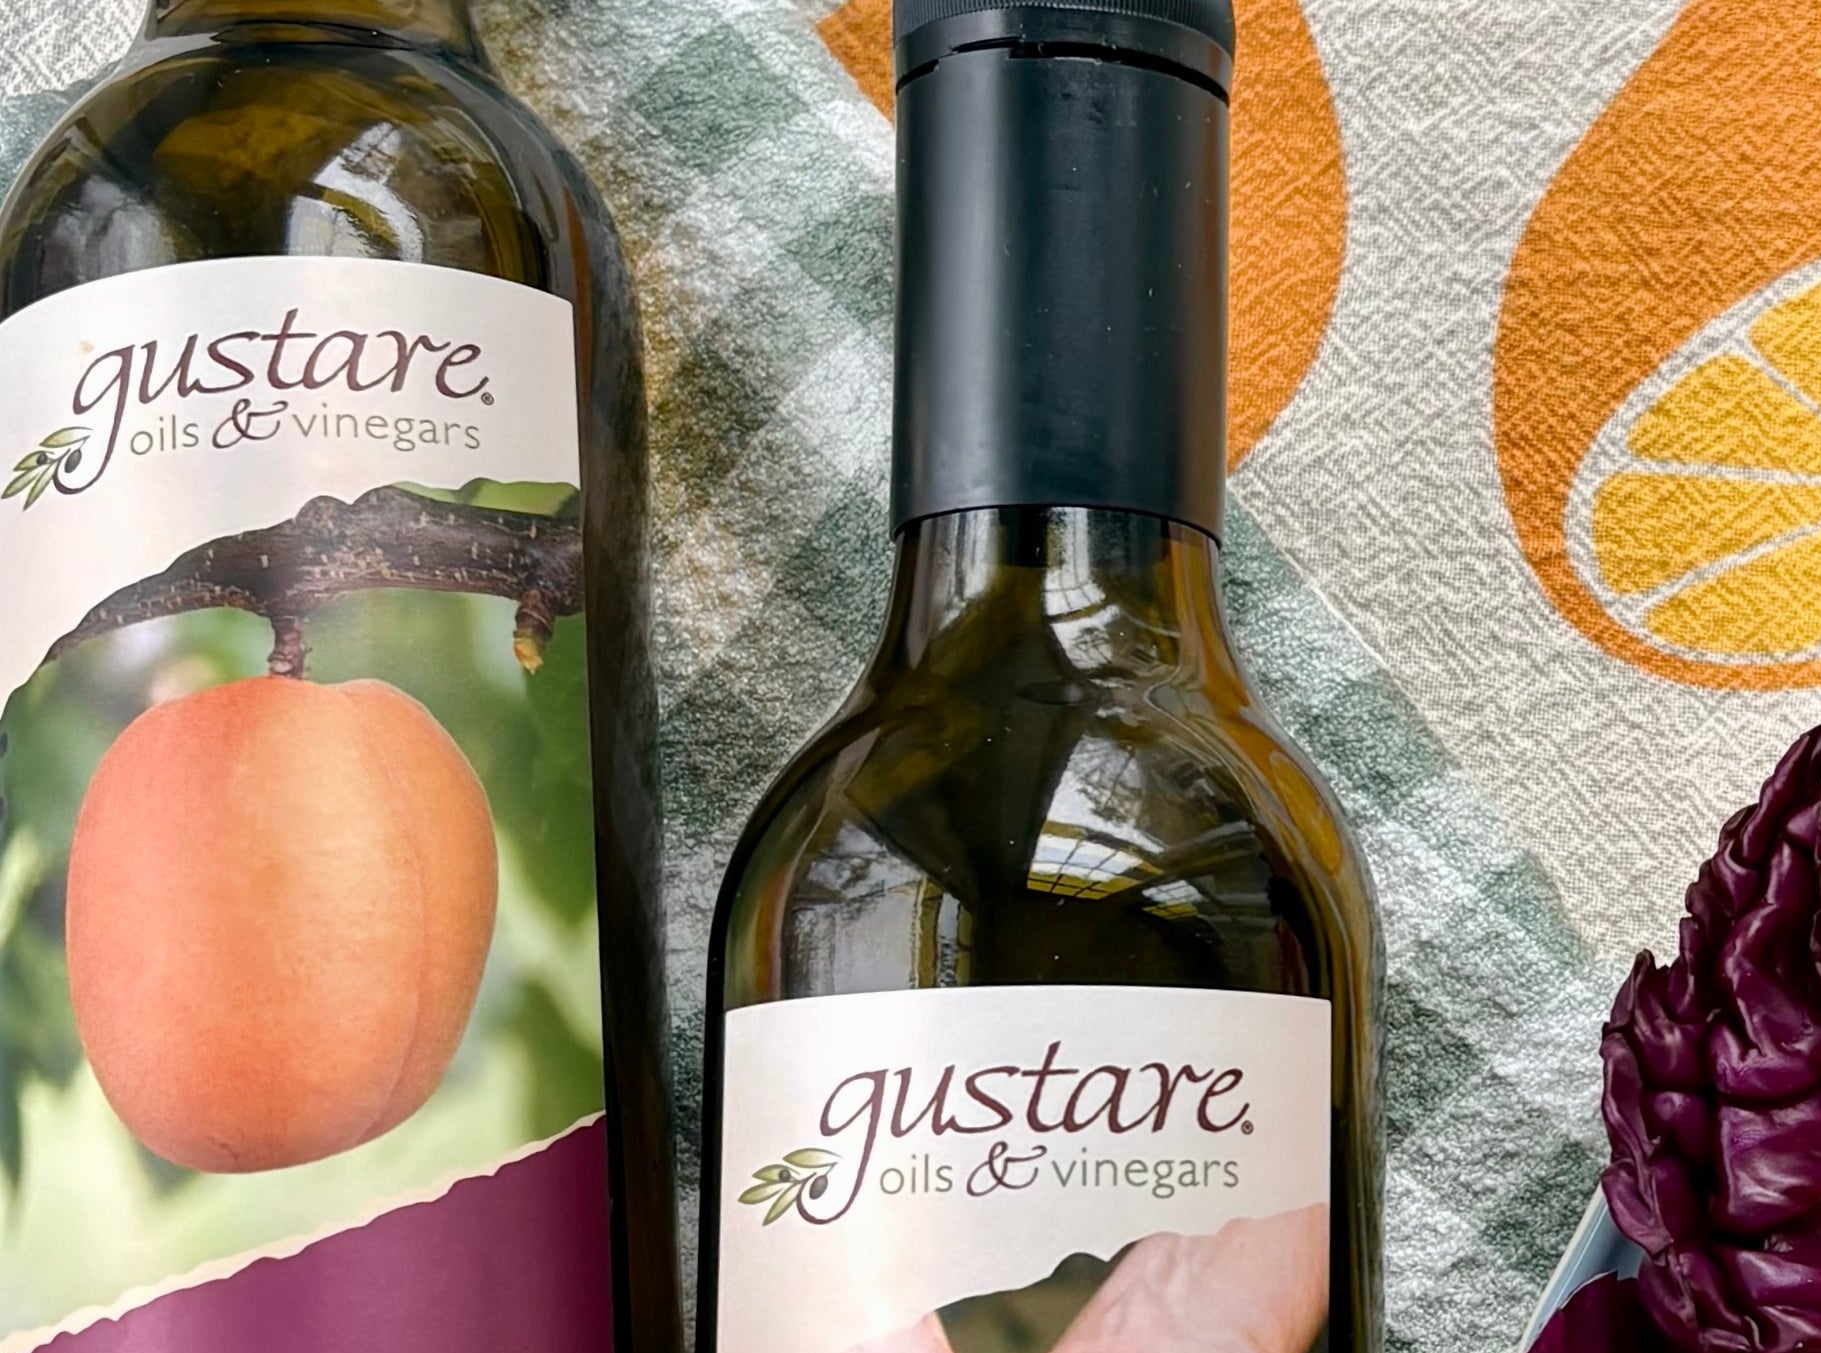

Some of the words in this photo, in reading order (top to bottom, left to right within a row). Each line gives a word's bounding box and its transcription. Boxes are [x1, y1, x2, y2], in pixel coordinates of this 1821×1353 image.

[130, 415, 200, 456] oils
[211, 398, 289, 449] &
[292, 402, 482, 451] vinegars
[879, 1153, 954, 1195] oils
[966, 1140, 1048, 1197] &
[1051, 1147, 1240, 1199] vinegars
